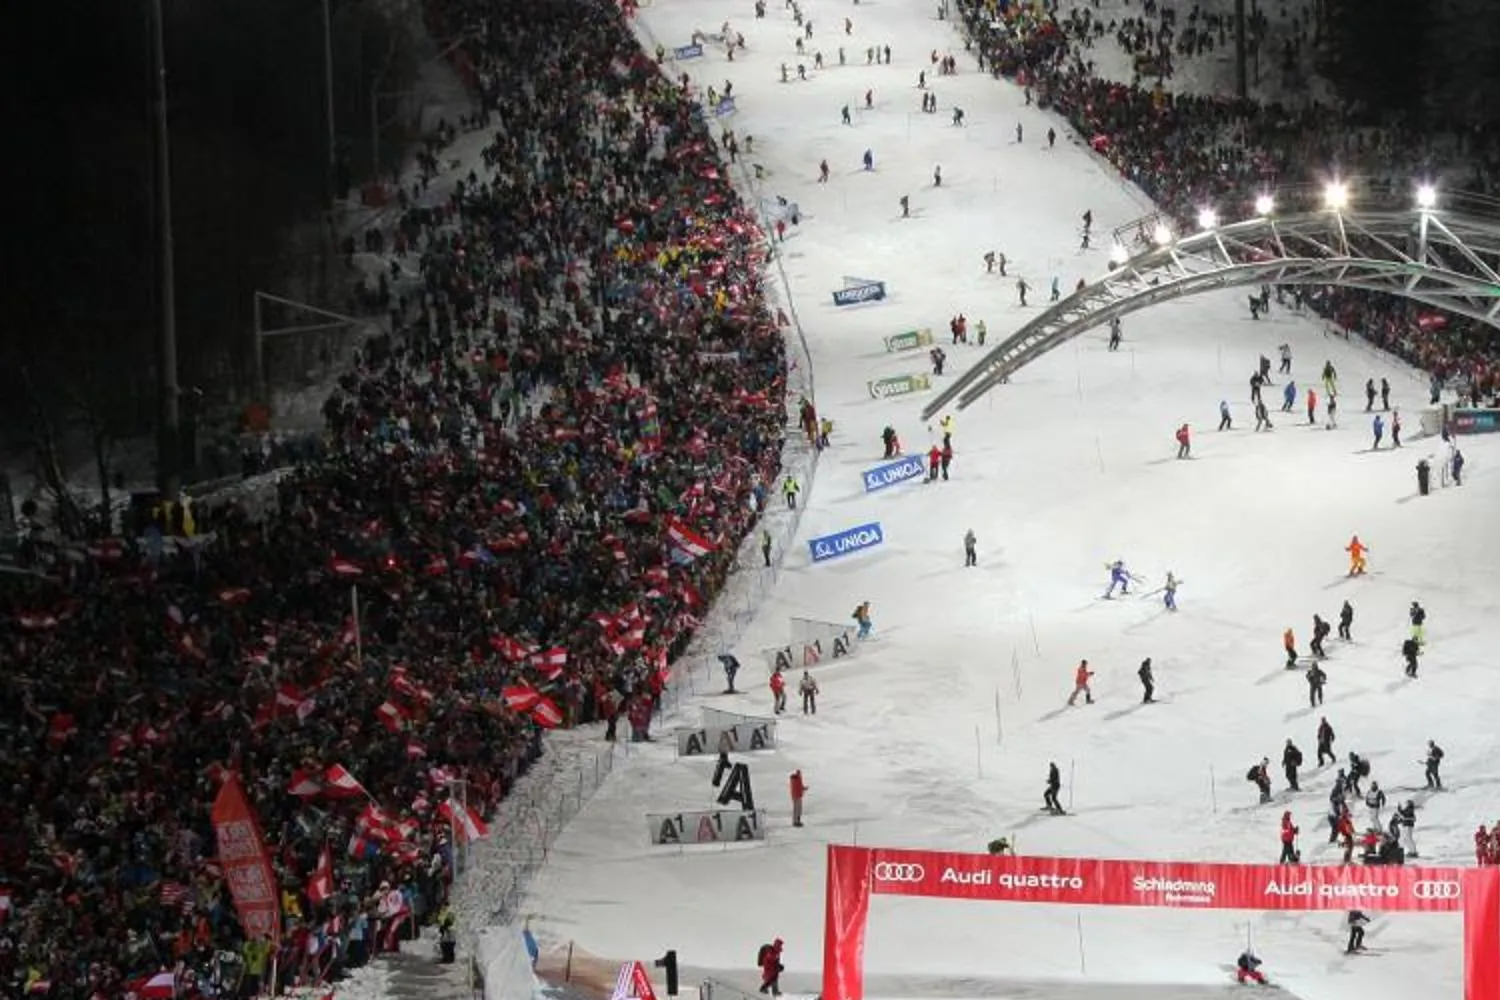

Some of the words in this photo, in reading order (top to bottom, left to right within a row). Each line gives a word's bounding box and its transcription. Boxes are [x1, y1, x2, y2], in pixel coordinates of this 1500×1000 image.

[883, 461, 923, 484] UNIQA
[835, 528, 879, 552] UNIQA
[941, 867, 992, 886] Audi
[999, 872, 1083, 891] quattro
[1264, 879, 1312, 896] Audi
[1319, 883, 1399, 899] quattro
